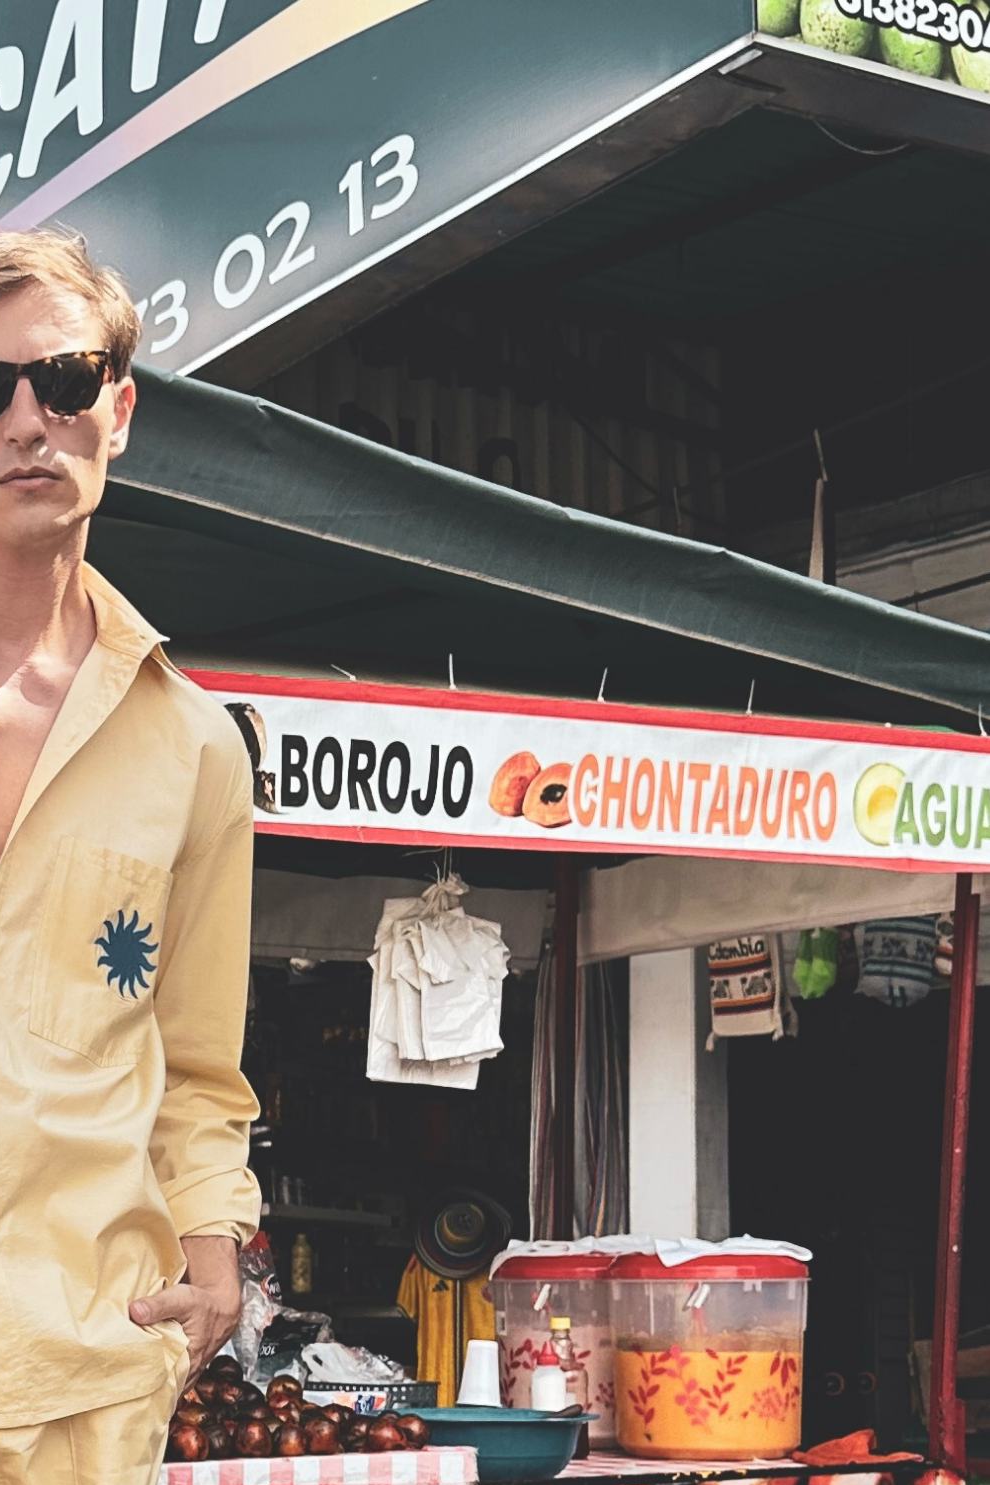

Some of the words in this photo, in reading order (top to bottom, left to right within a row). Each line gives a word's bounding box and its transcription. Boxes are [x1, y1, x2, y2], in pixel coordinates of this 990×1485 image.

[837, 0, 990, 48] 138230
[213, 200, 316, 309] 02
[338, 134, 419, 237] 13
[281, 734, 474, 818] BOROJO
[571, 753, 837, 841] CHONTADURO
[894, 782, 990, 849] AGUA
